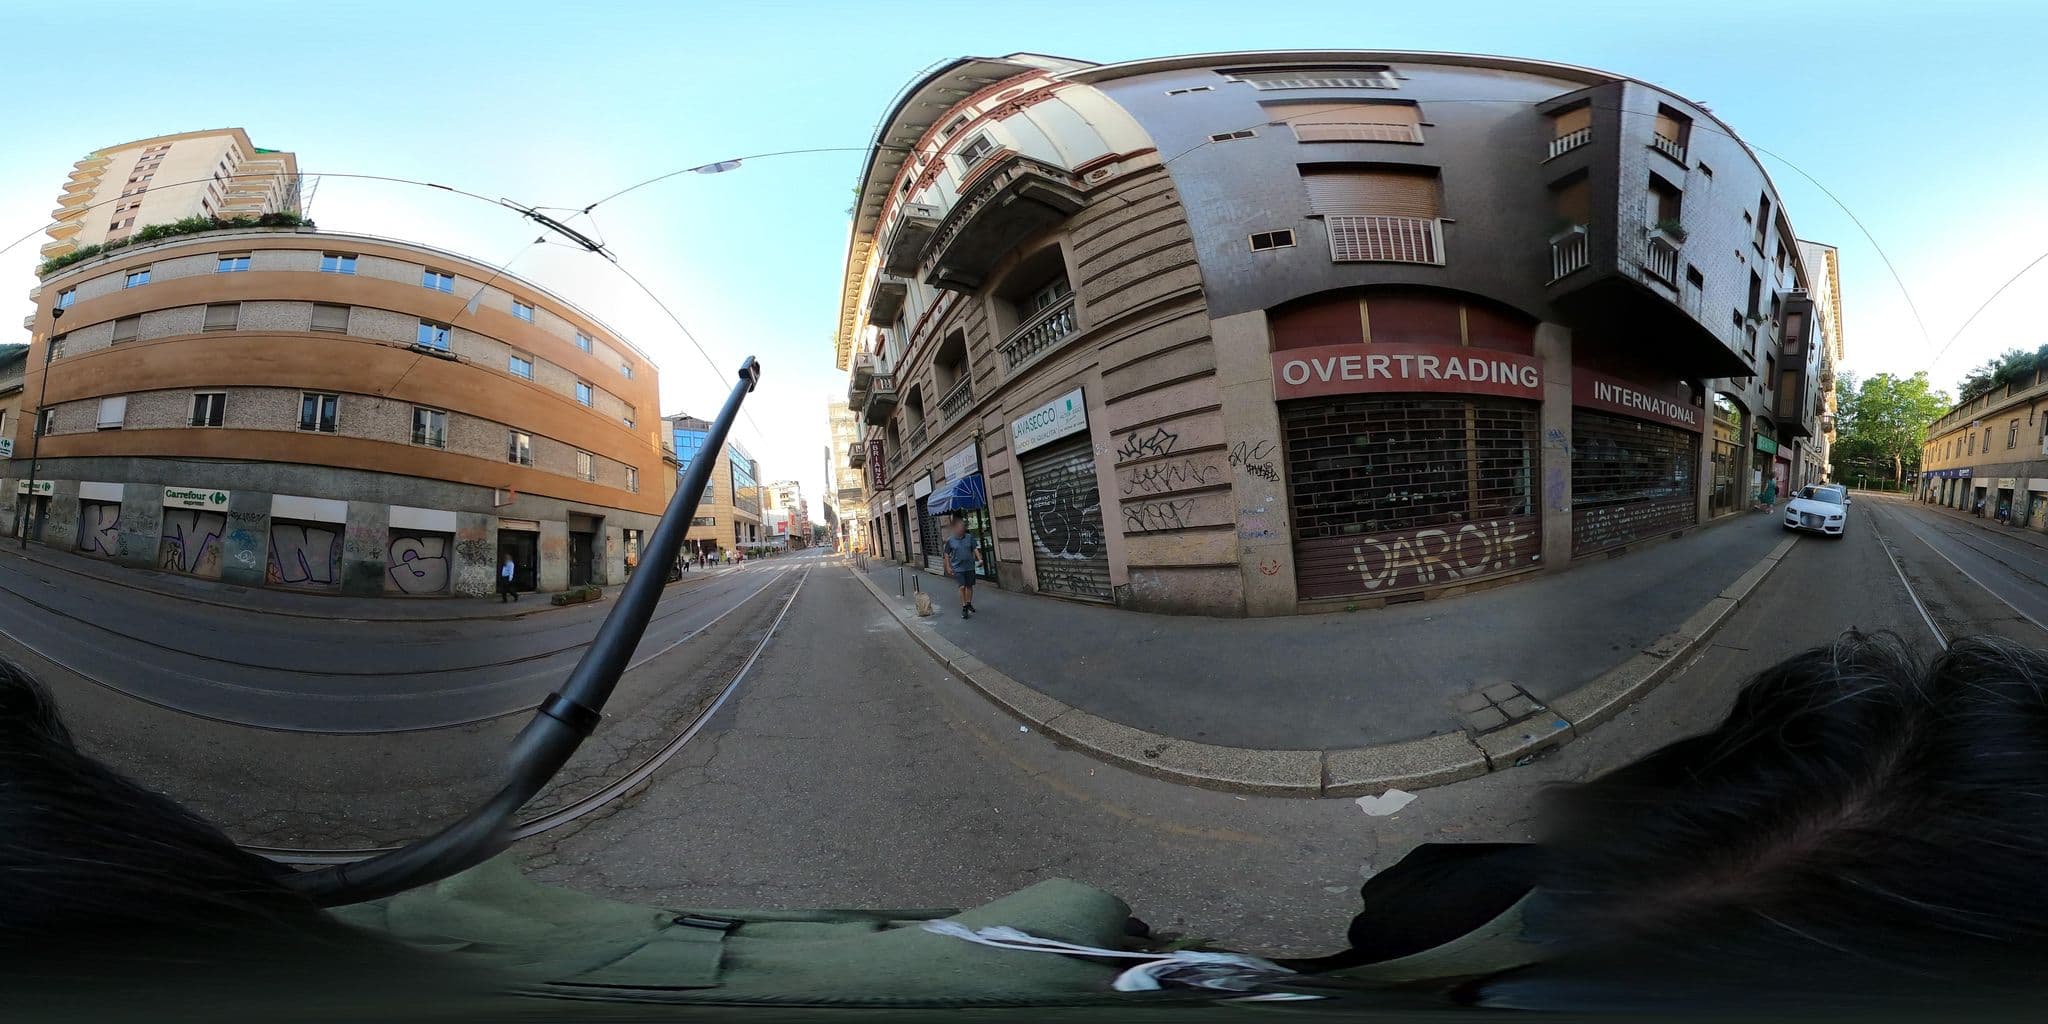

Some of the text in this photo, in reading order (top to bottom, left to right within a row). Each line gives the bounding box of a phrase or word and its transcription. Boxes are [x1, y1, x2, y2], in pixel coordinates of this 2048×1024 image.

[1282, 354, 1539, 389] OVERTRADING
[1594, 381, 1696, 425] INTERNATIONAL
[872, 444, 883, 485] BRIANZA
[165, 489, 207, 500] Carrefour
